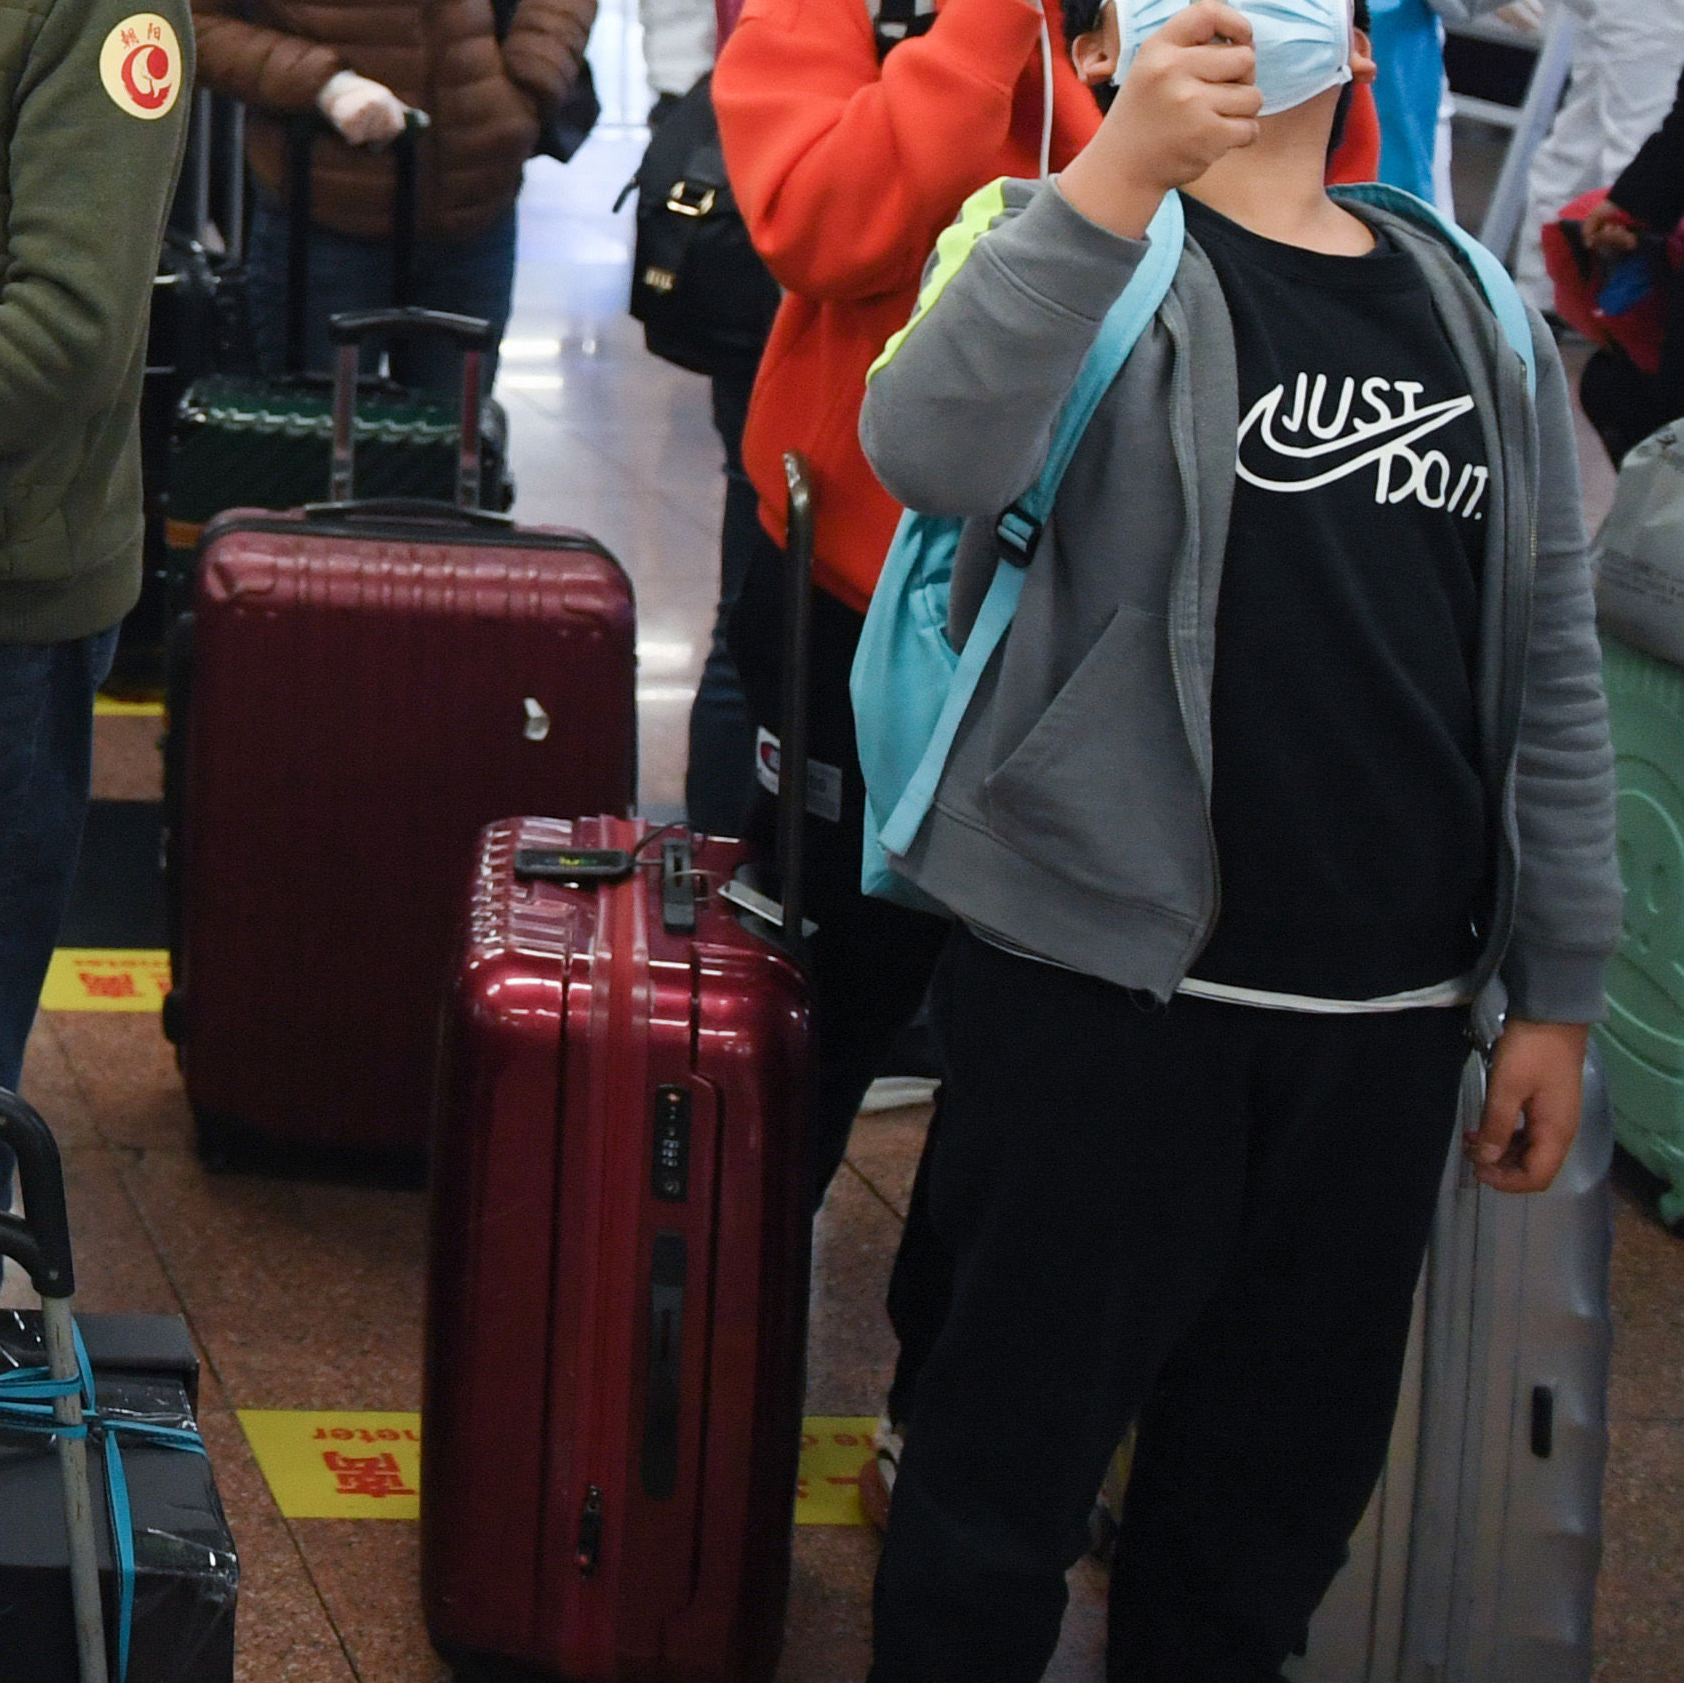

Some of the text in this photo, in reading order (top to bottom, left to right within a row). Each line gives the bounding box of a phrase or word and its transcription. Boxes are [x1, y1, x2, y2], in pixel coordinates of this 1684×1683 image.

[120, 22, 162, 48] 朝阳
[1282, 372, 1424, 439] JUST
[1375, 445, 1450, 509] DO
[322, 1450, 416, 1498] 离
